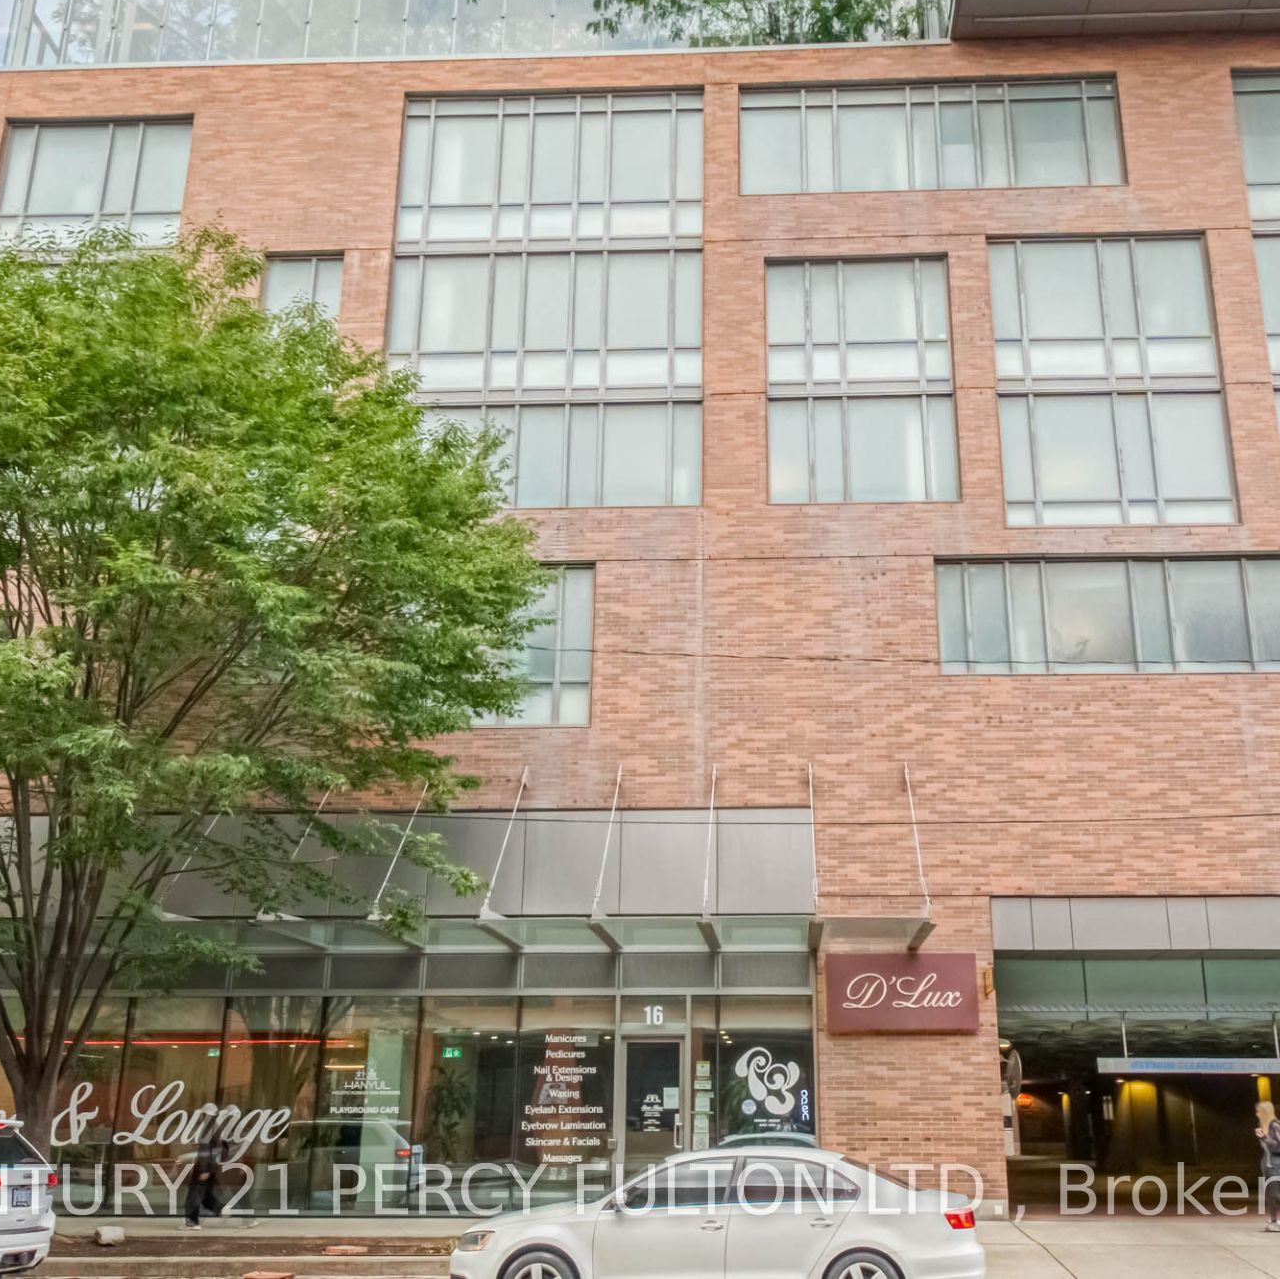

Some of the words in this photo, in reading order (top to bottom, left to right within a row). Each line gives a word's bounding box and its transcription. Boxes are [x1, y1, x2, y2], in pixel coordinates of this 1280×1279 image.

[842, 972, 963, 1009] D'Lux
[643, 1005, 664, 1026] 16
[545, 1034, 587, 1043] Manicures
[545, 1050, 586, 1059] Pedicures
[533, 1066, 550, 1075] Nail
[552, 1065, 597, 1075] Extensions
[546, 1074, 553, 1082] &
[555, 1074, 583, 1083] Design
[549, 1089, 580, 1099] Waxing
[330, 1106, 379, 1114] PLAYGROUND
[380, 1106, 401, 1114] CAFE
[525, 1105, 556, 1116] Eyelash
[558, 1105, 604, 1114] Extensions
[50, 1081, 99, 1147] &
[112, 1080, 292, 1165] Lounge
[521, 1121, 559, 1132] Eyebrow
[560, 1121, 606, 1130] Lamination
[525, 1137, 561, 1146] Skincare
[563, 1137, 570, 1146] &
[572, 1137, 601, 1146] Facials
[542, 1153, 583, 1163] Massages
